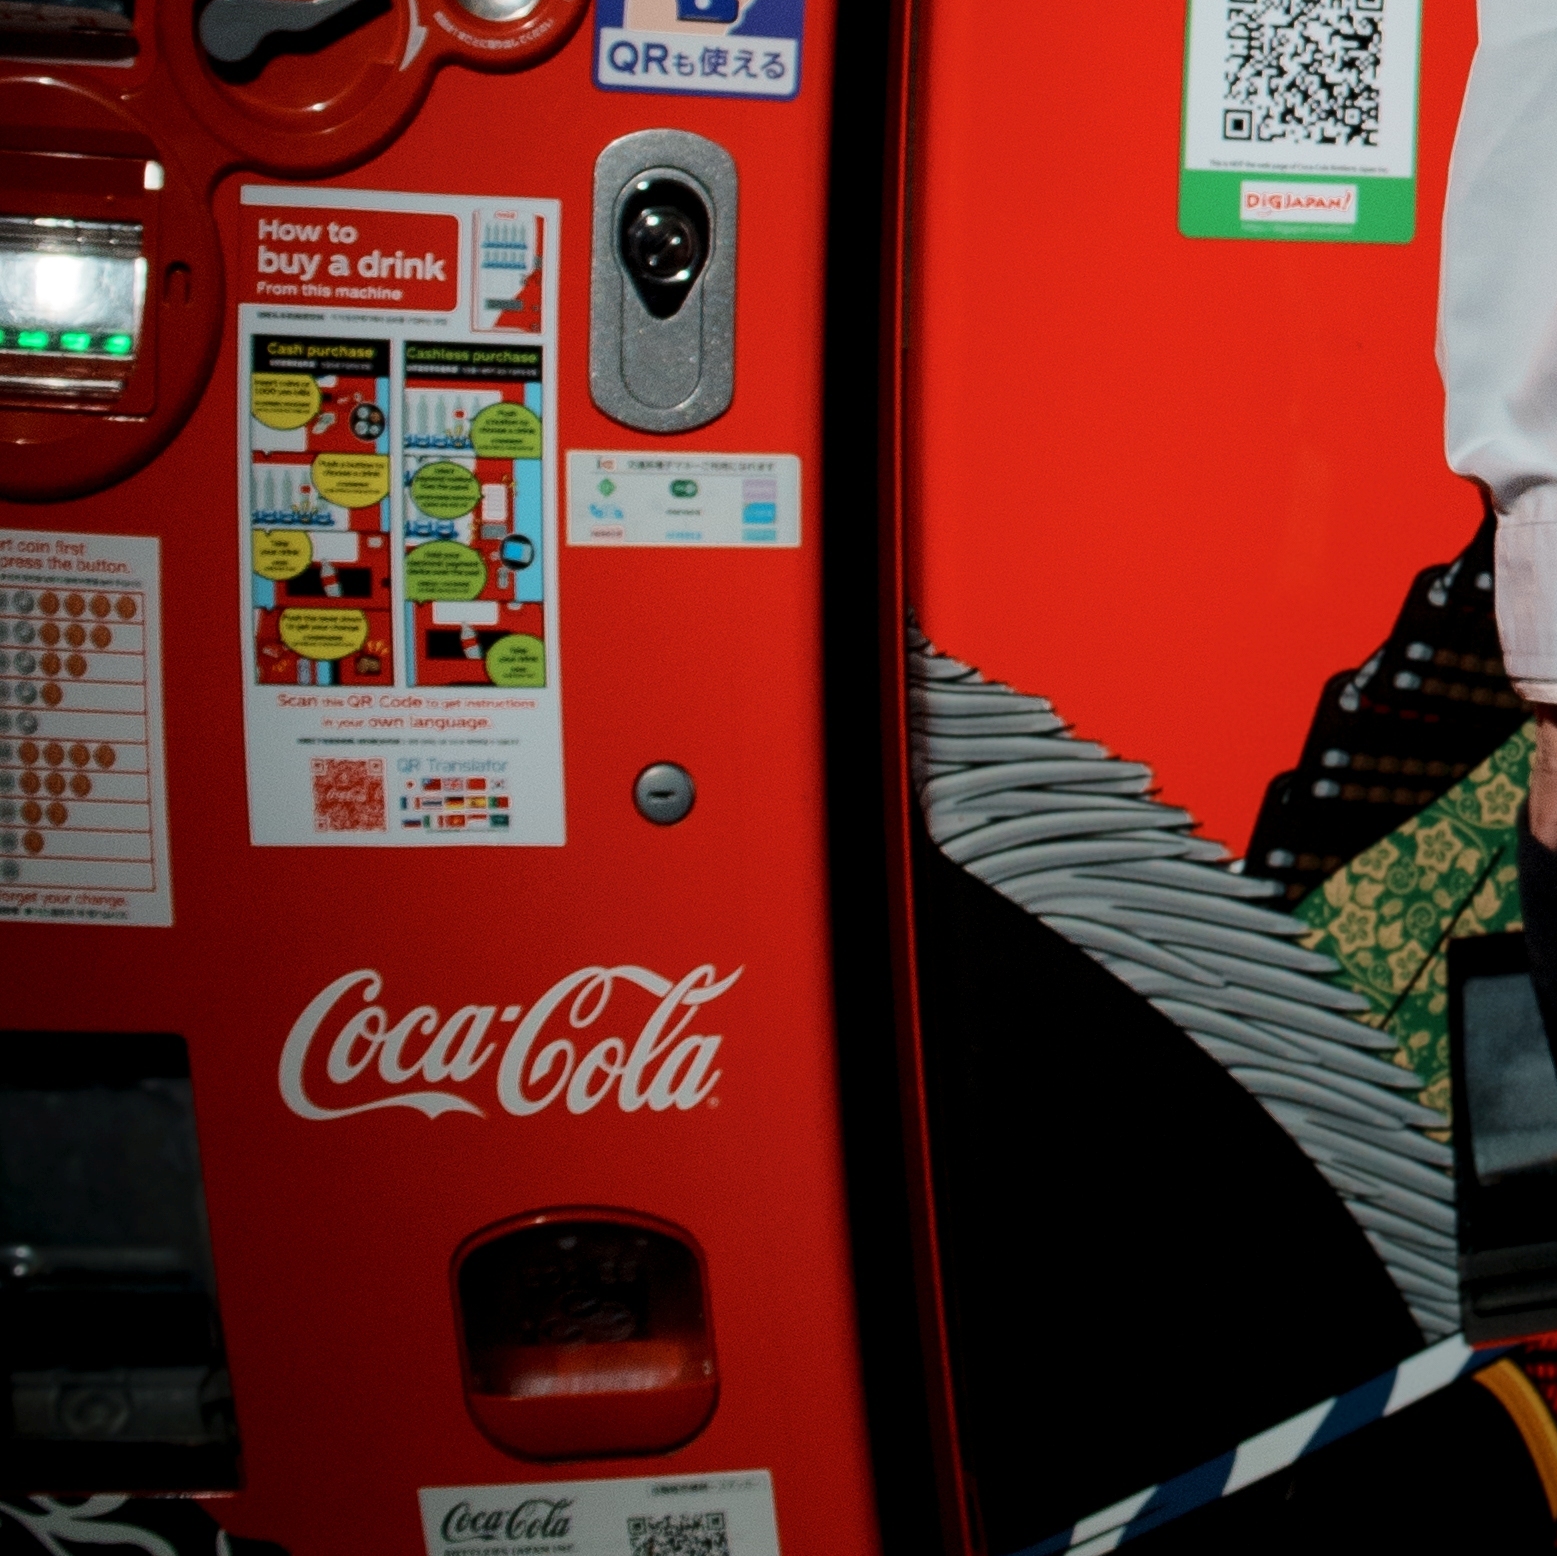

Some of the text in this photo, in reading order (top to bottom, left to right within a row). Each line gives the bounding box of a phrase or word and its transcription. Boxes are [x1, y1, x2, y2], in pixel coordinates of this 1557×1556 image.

[605, 38, 787, 80] QRも使える
[257, 218, 359, 245] How to
[257, 244, 447, 283] buy a drink
[301, 281, 333, 299] this
[334, 284, 404, 302] machine
[266, 341, 376, 363] Cash purchase
[406, 345, 539, 368] Cashless purchase
[16, 540, 51, 555] coin
[276, 693, 319, 709] Scan
[346, 694, 374, 710] QR
[378, 695, 424, 709] Code
[368, 717, 404, 729] own
[277, 963, 747, 1122] Coca-Cola
[440, 1497, 577, 1545] Coca-Cola
